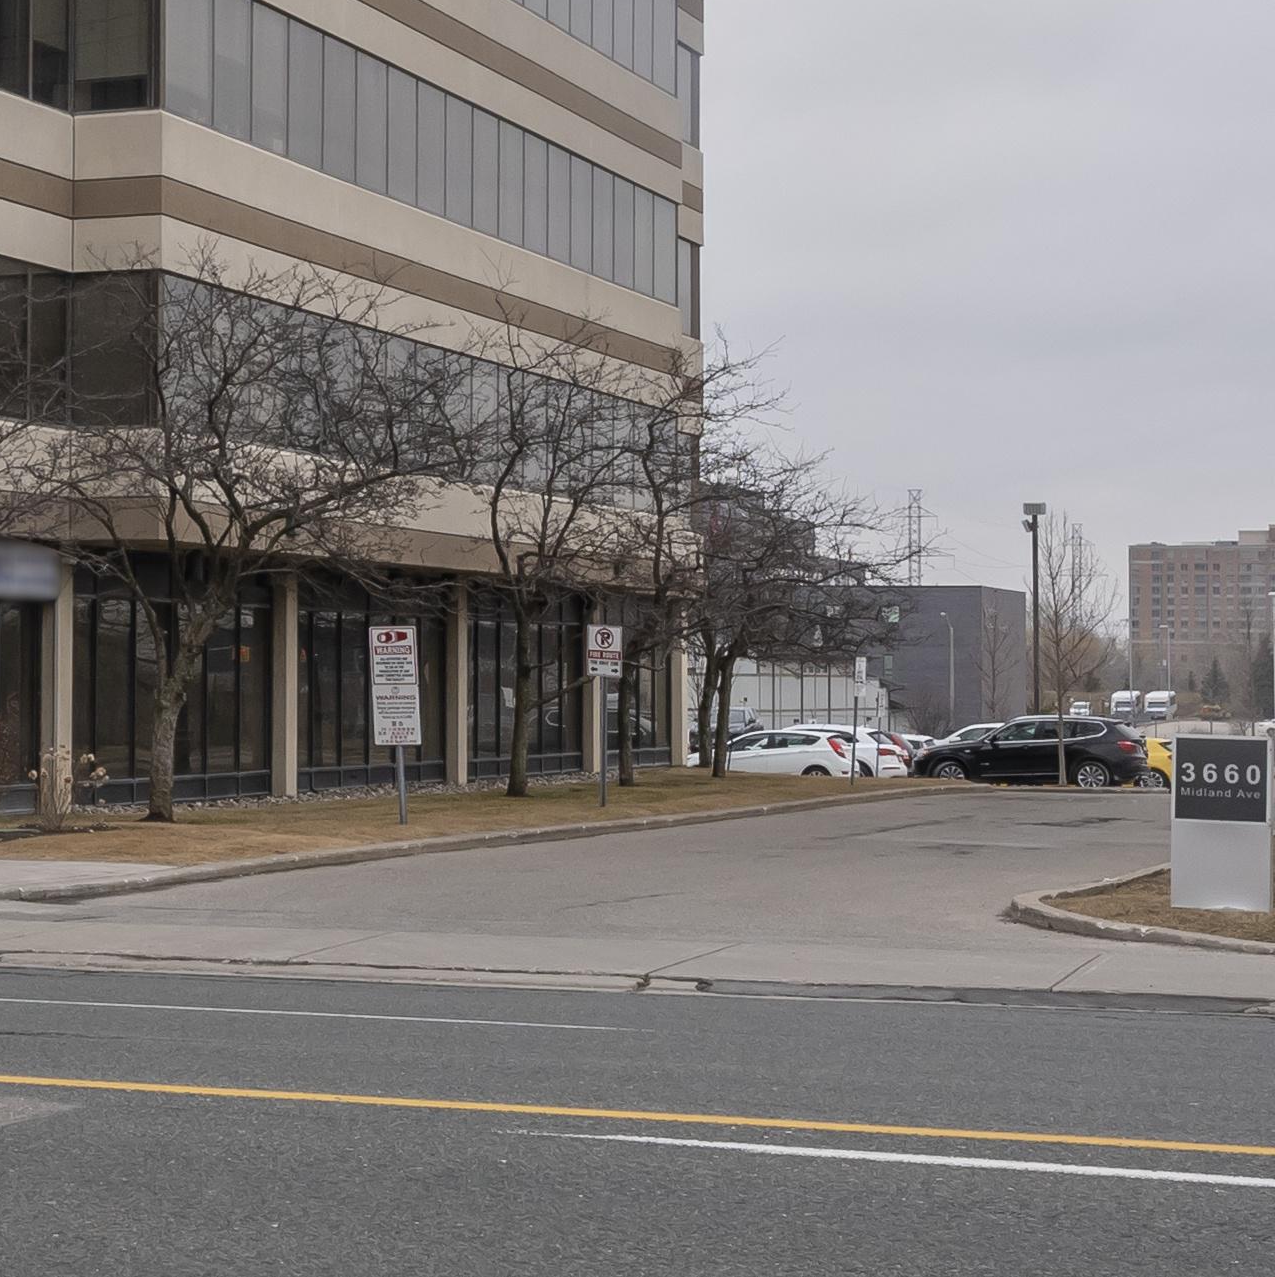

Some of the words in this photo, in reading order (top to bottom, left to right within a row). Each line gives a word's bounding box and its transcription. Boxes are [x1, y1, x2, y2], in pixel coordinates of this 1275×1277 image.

[375, 645, 411, 655] WARNING
[1180, 762, 1261, 785] 3660
[1180, 787, 1232, 798] Midland
[1236, 789, 1261, 799] Ave
